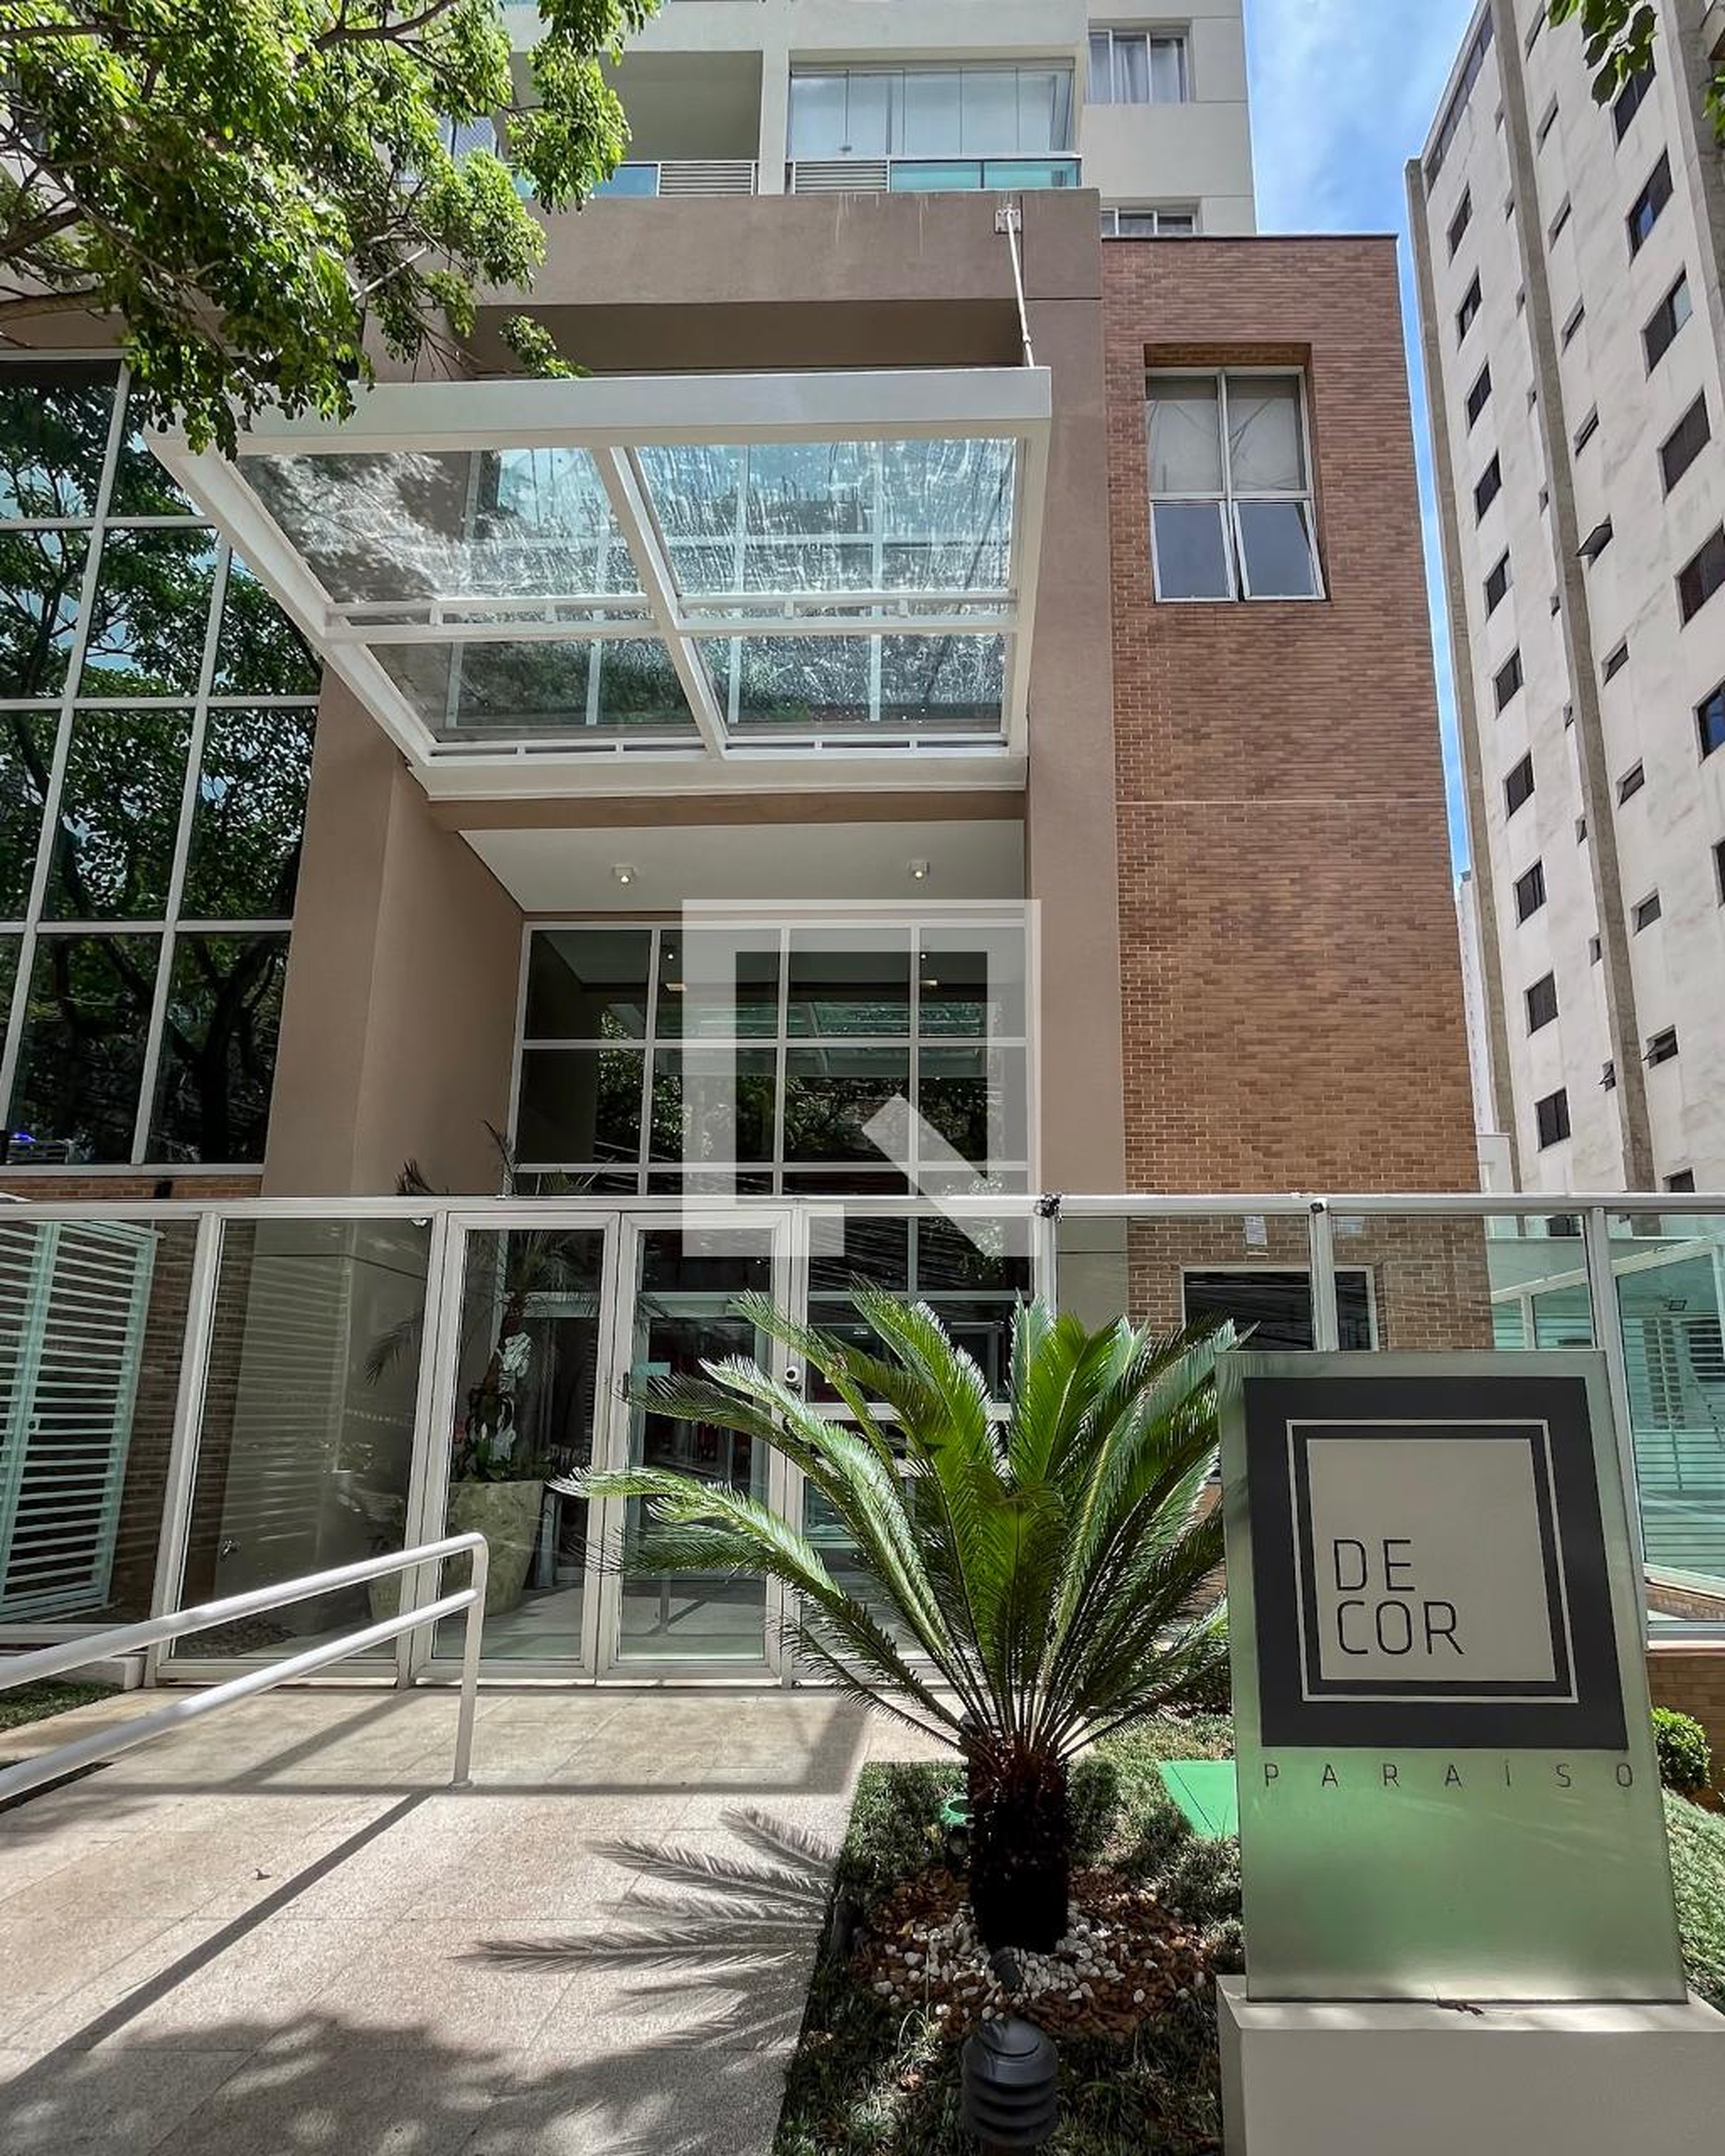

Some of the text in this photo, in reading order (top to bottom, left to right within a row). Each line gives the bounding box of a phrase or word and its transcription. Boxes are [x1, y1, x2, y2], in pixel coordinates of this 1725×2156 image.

[1333, 1538, 1416, 1592] DE
[1336, 1599, 1465, 1656] COR
[1264, 1759, 1634, 1788] PARAÍSO
